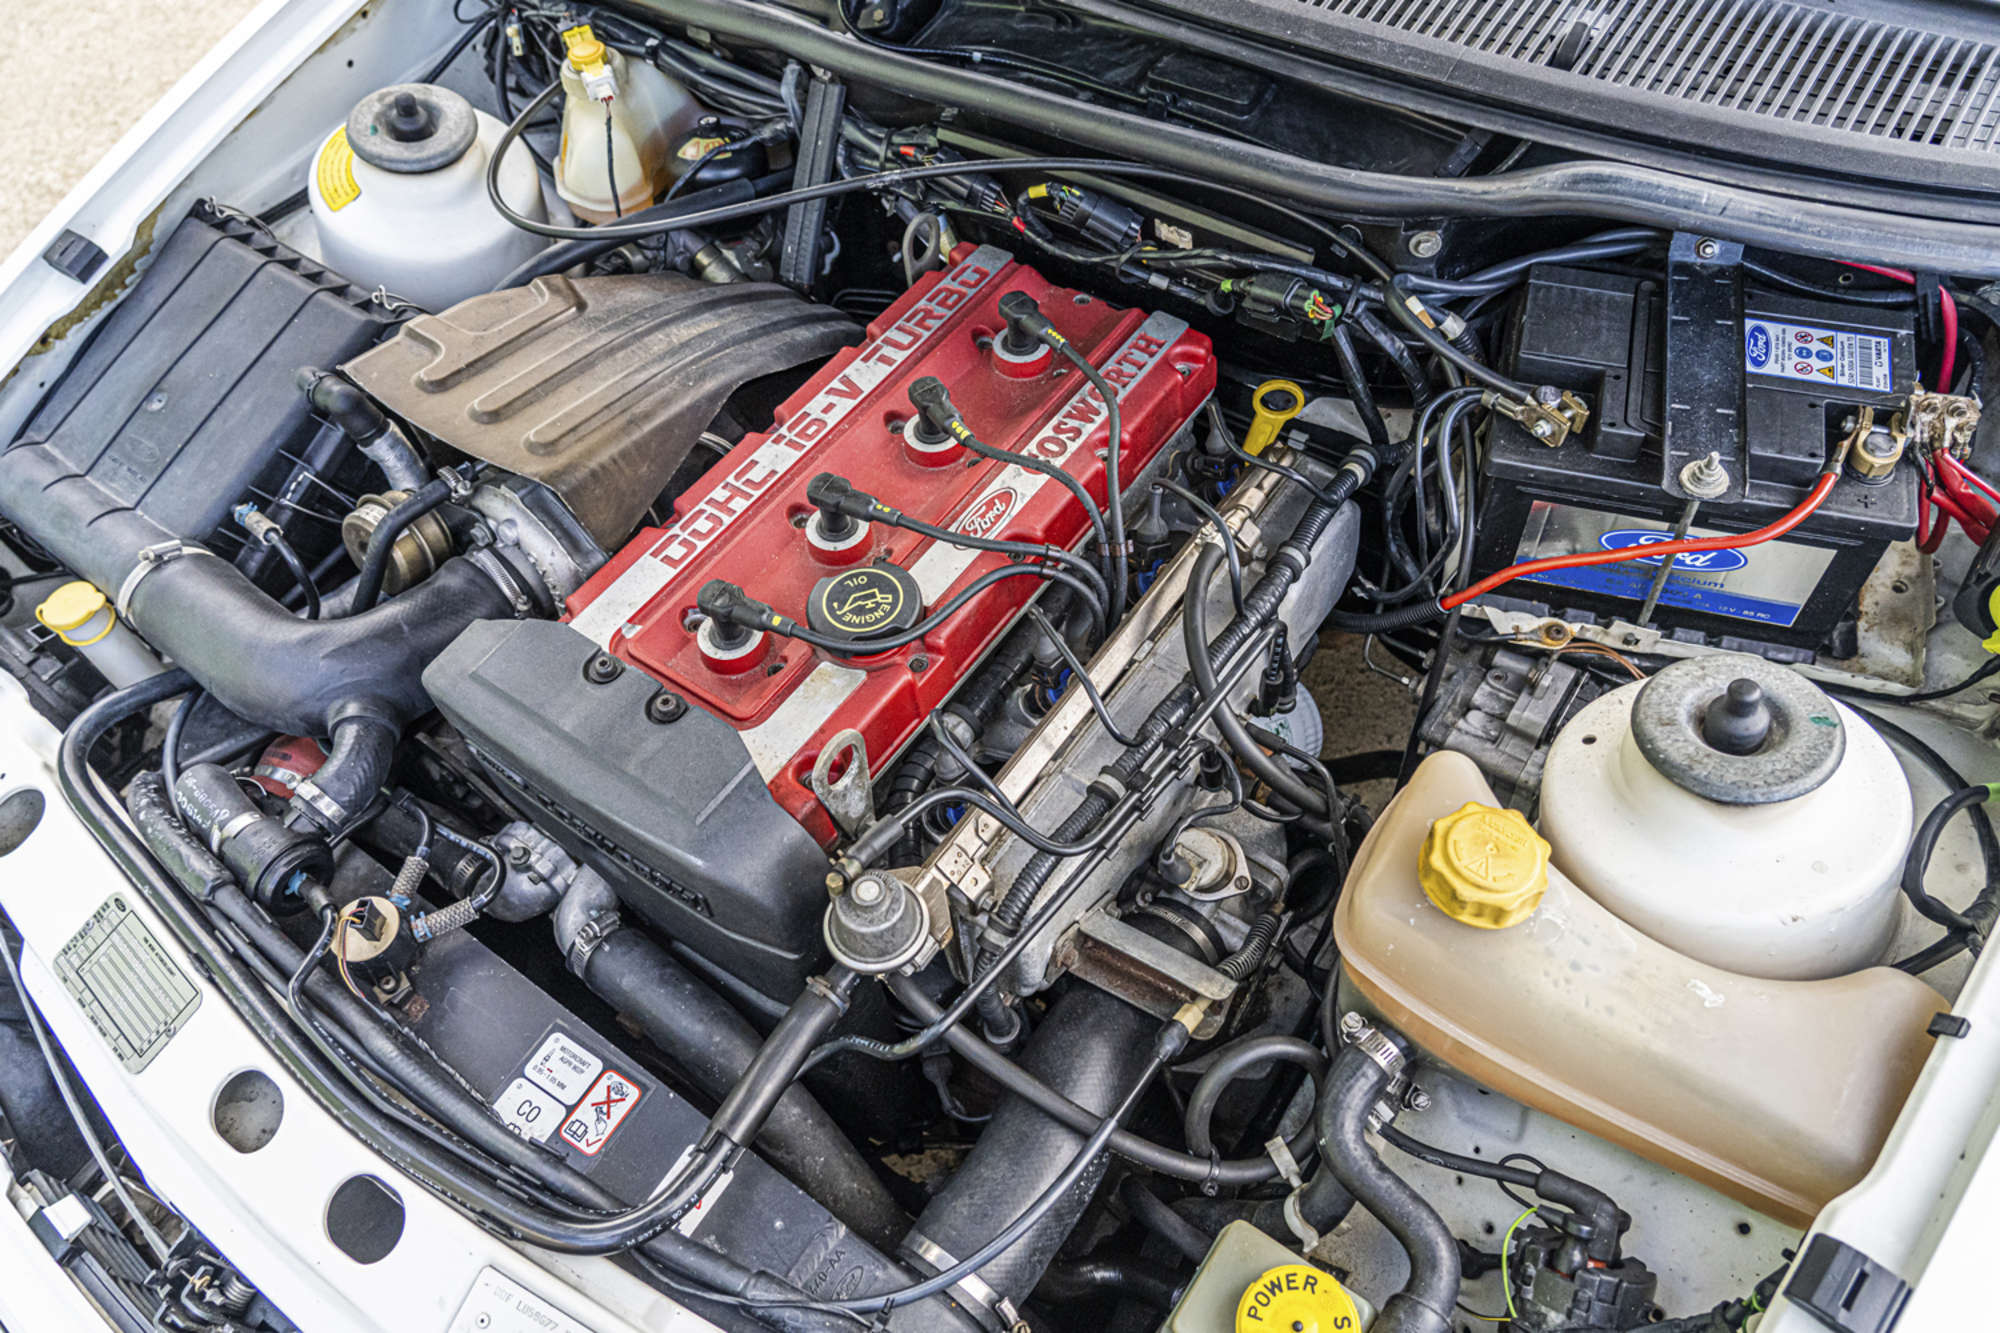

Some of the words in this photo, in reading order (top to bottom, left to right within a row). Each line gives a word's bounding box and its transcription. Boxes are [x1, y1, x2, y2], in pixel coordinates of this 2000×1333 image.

[1749, 331, 1767, 361] Ford
[1874, 340, 1883, 358] VARTA
[649, 459, 779, 571] DOHC
[860, 263, 991, 367] TURBO
[964, 499, 1007, 540] Ford
[844, 575, 868, 588] OIL
[842, 603, 891, 624] ENGINE
[516, 1099, 542, 1123] CO
[1246, 1272, 1318, 1322] POWER
